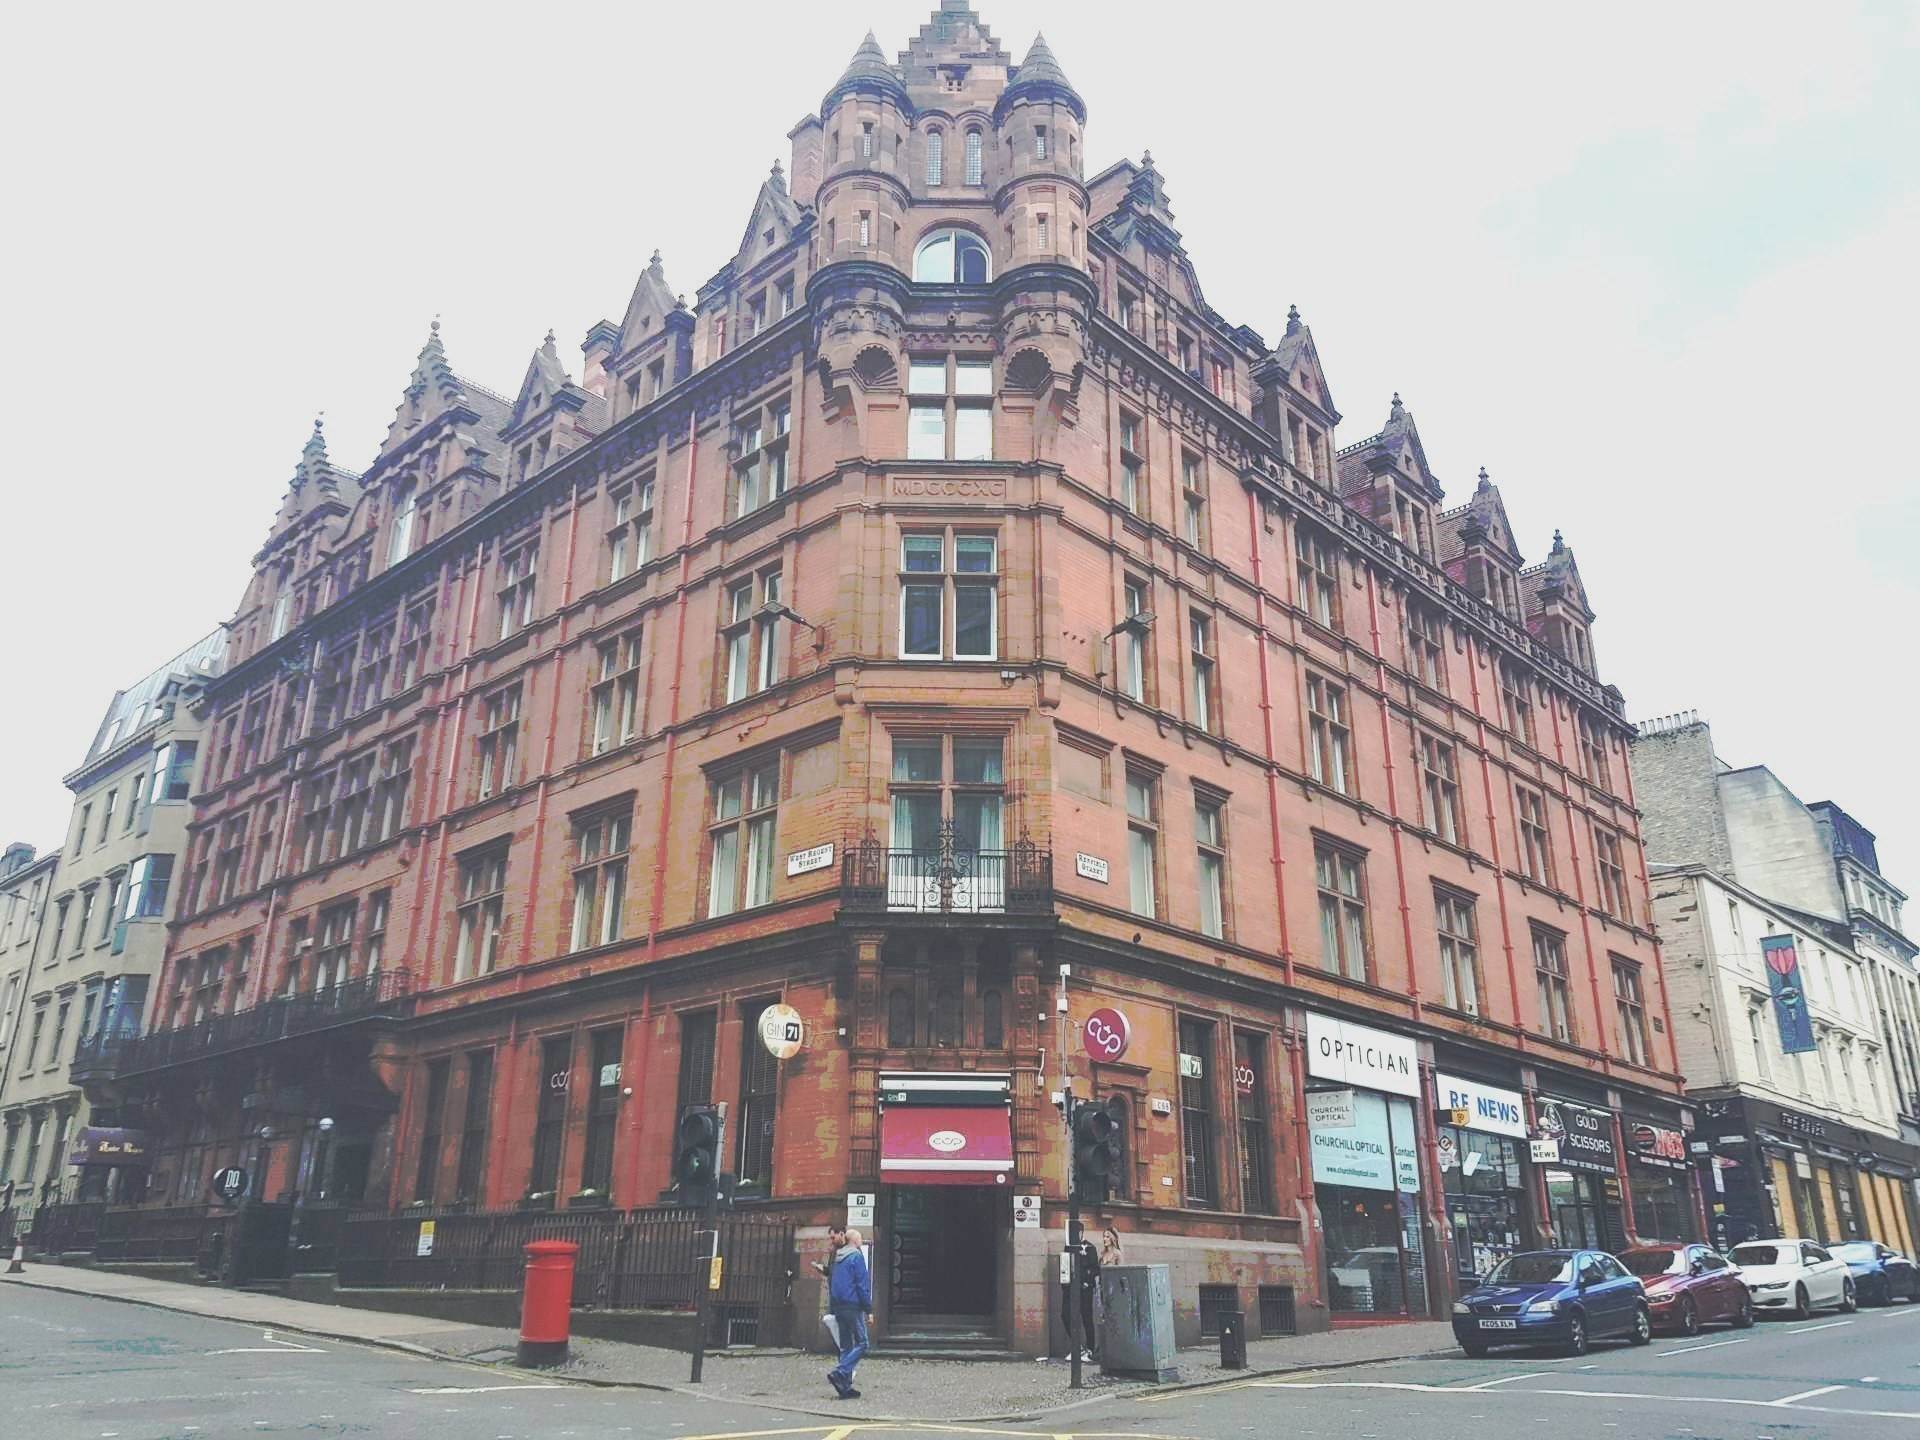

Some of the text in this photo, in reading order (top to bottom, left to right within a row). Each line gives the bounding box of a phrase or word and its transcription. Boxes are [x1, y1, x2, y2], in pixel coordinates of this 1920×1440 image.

[893, 481, 1004, 497] MDCCCXC
[1320, 1037, 1409, 1074] OPTICIAN
[1310, 1105, 1350, 1114] CHURCHILL
[1315, 1113, 1346, 1122] OPTICAL
[1477, 1097, 1519, 1123] NEWS
[1575, 1114, 1599, 1131] GOLD
[1314, 1134, 1385, 1155] CHURCHILL OPTICAL
[1569, 1133, 1612, 1153] SCISSORS
